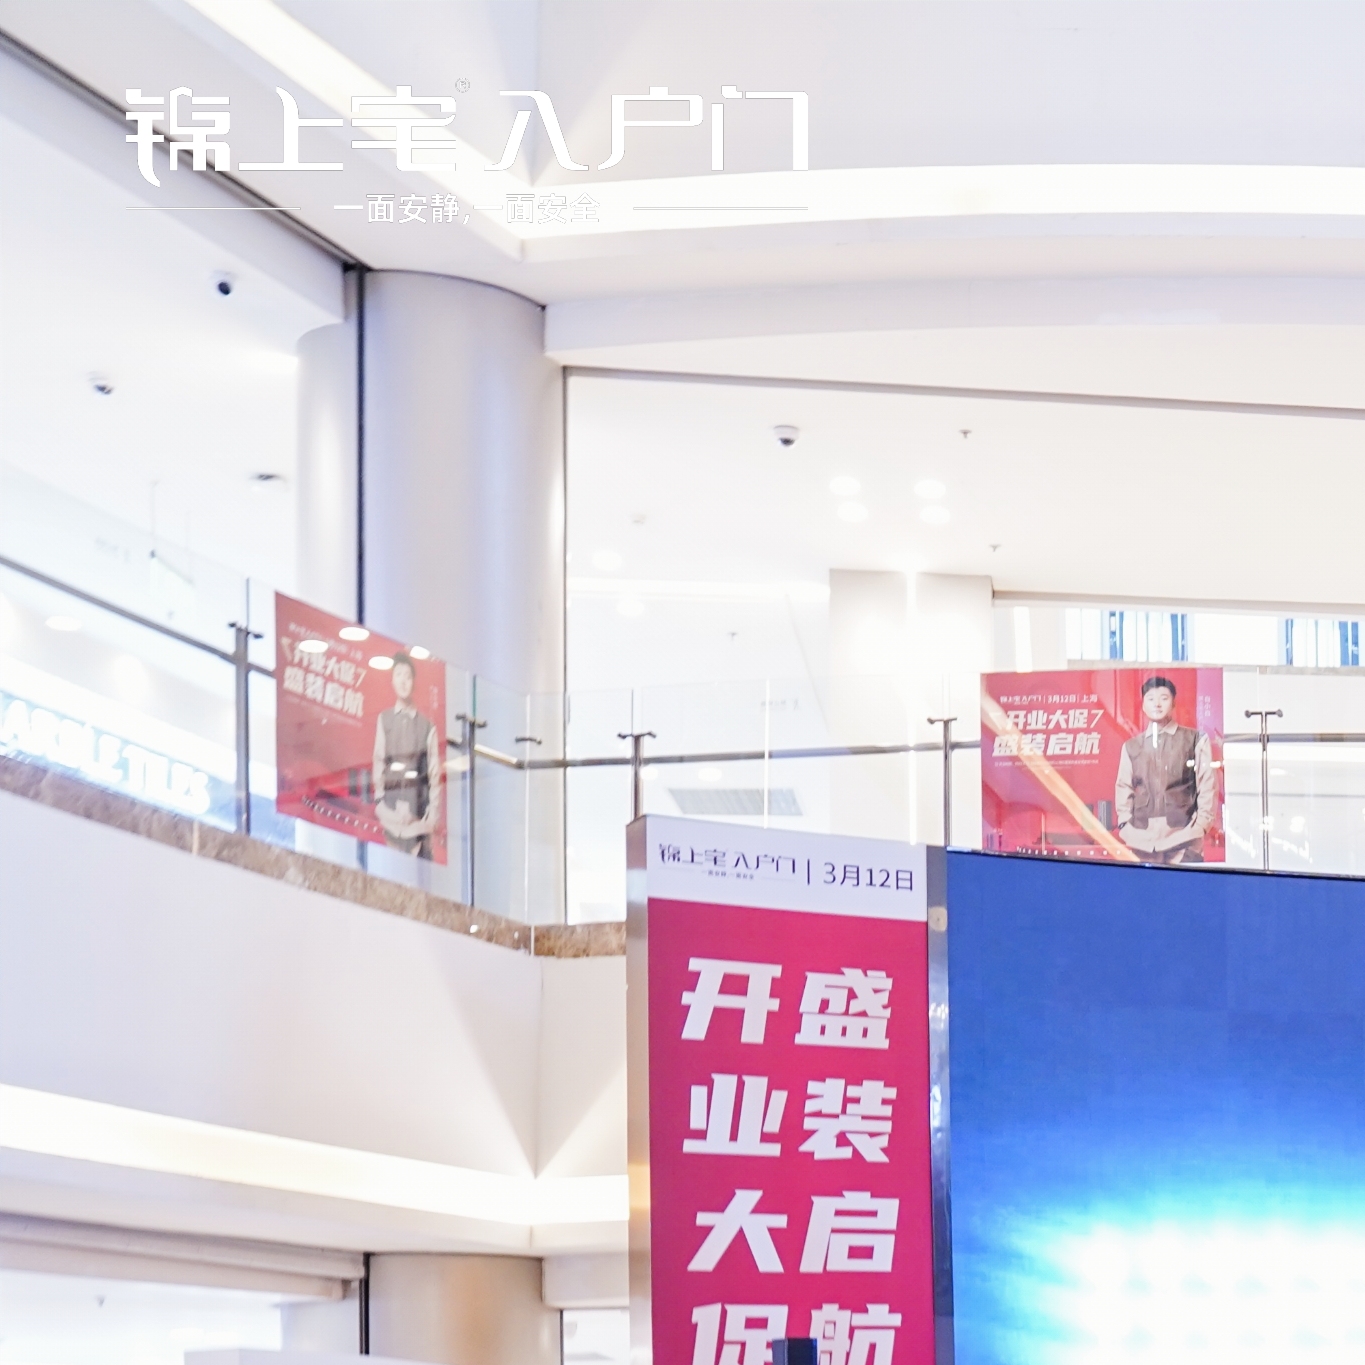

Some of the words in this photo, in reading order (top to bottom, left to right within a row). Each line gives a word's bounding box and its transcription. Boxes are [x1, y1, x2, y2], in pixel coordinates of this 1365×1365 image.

[1006, 709, 1088, 730] 开业大促
[992, 732, 1101, 757] 盛装启航
[822, 861, 914, 892] 3月12日
